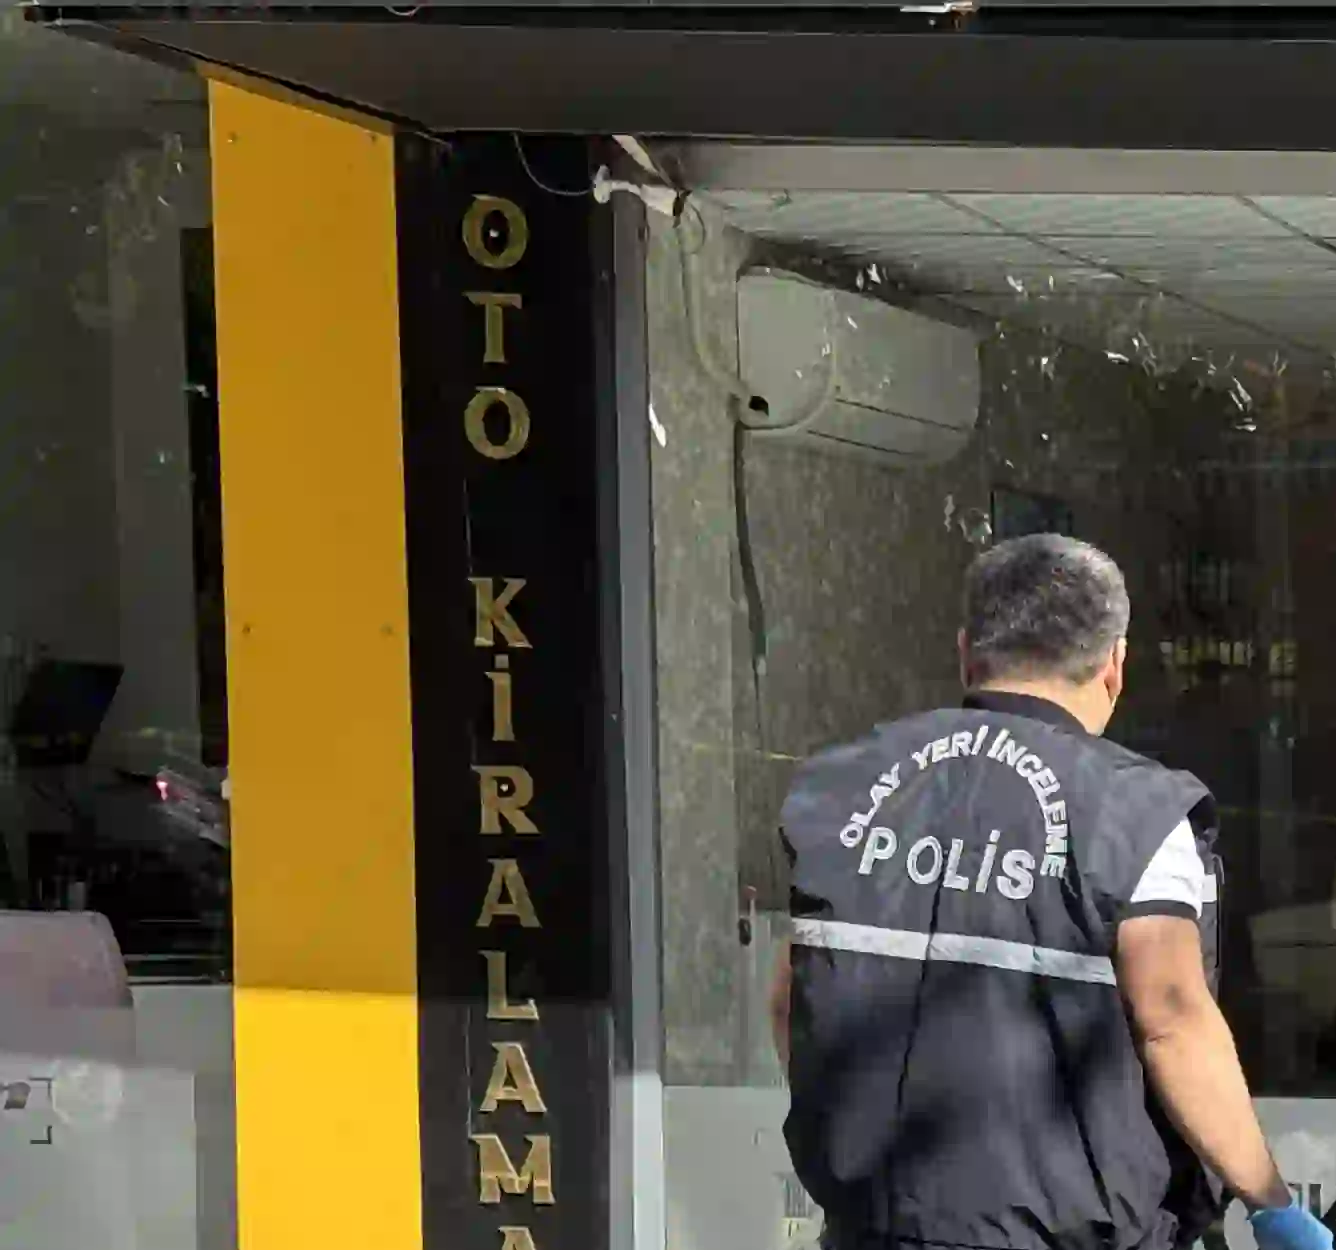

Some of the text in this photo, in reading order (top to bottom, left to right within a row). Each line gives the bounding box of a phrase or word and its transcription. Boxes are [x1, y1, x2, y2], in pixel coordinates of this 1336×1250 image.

[462, 194, 531, 459] OTO
[839, 763, 901, 849] OLAY
[858, 829, 1036, 900] POLİS
